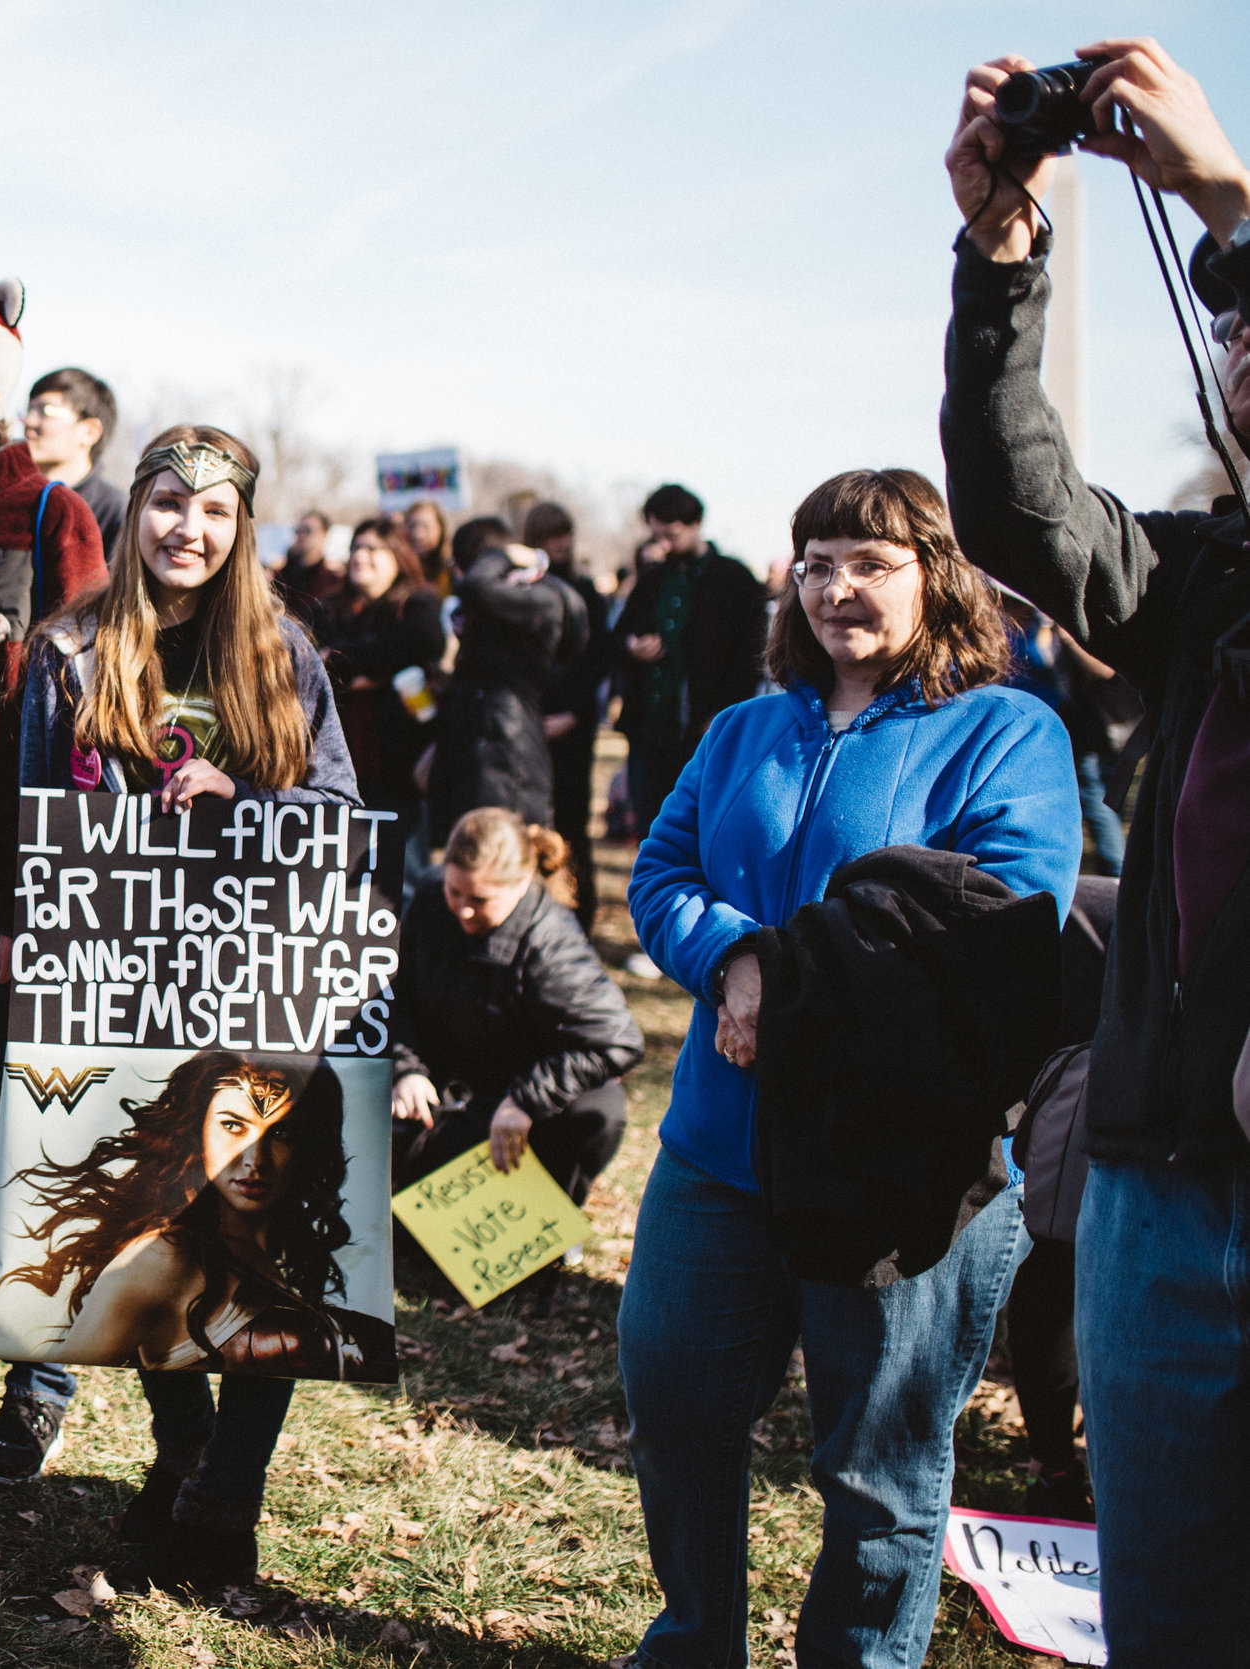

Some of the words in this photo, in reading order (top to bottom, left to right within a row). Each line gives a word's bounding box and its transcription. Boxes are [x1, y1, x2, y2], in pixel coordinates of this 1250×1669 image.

[18, 786, 66, 855] I
[78, 793, 216, 858] WILL
[15, 981, 391, 1056] THEMSELVES
[417, 1150, 495, 1210] Resist
[452, 1199, 526, 1252] Vote
[472, 1217, 564, 1293] Repeat
